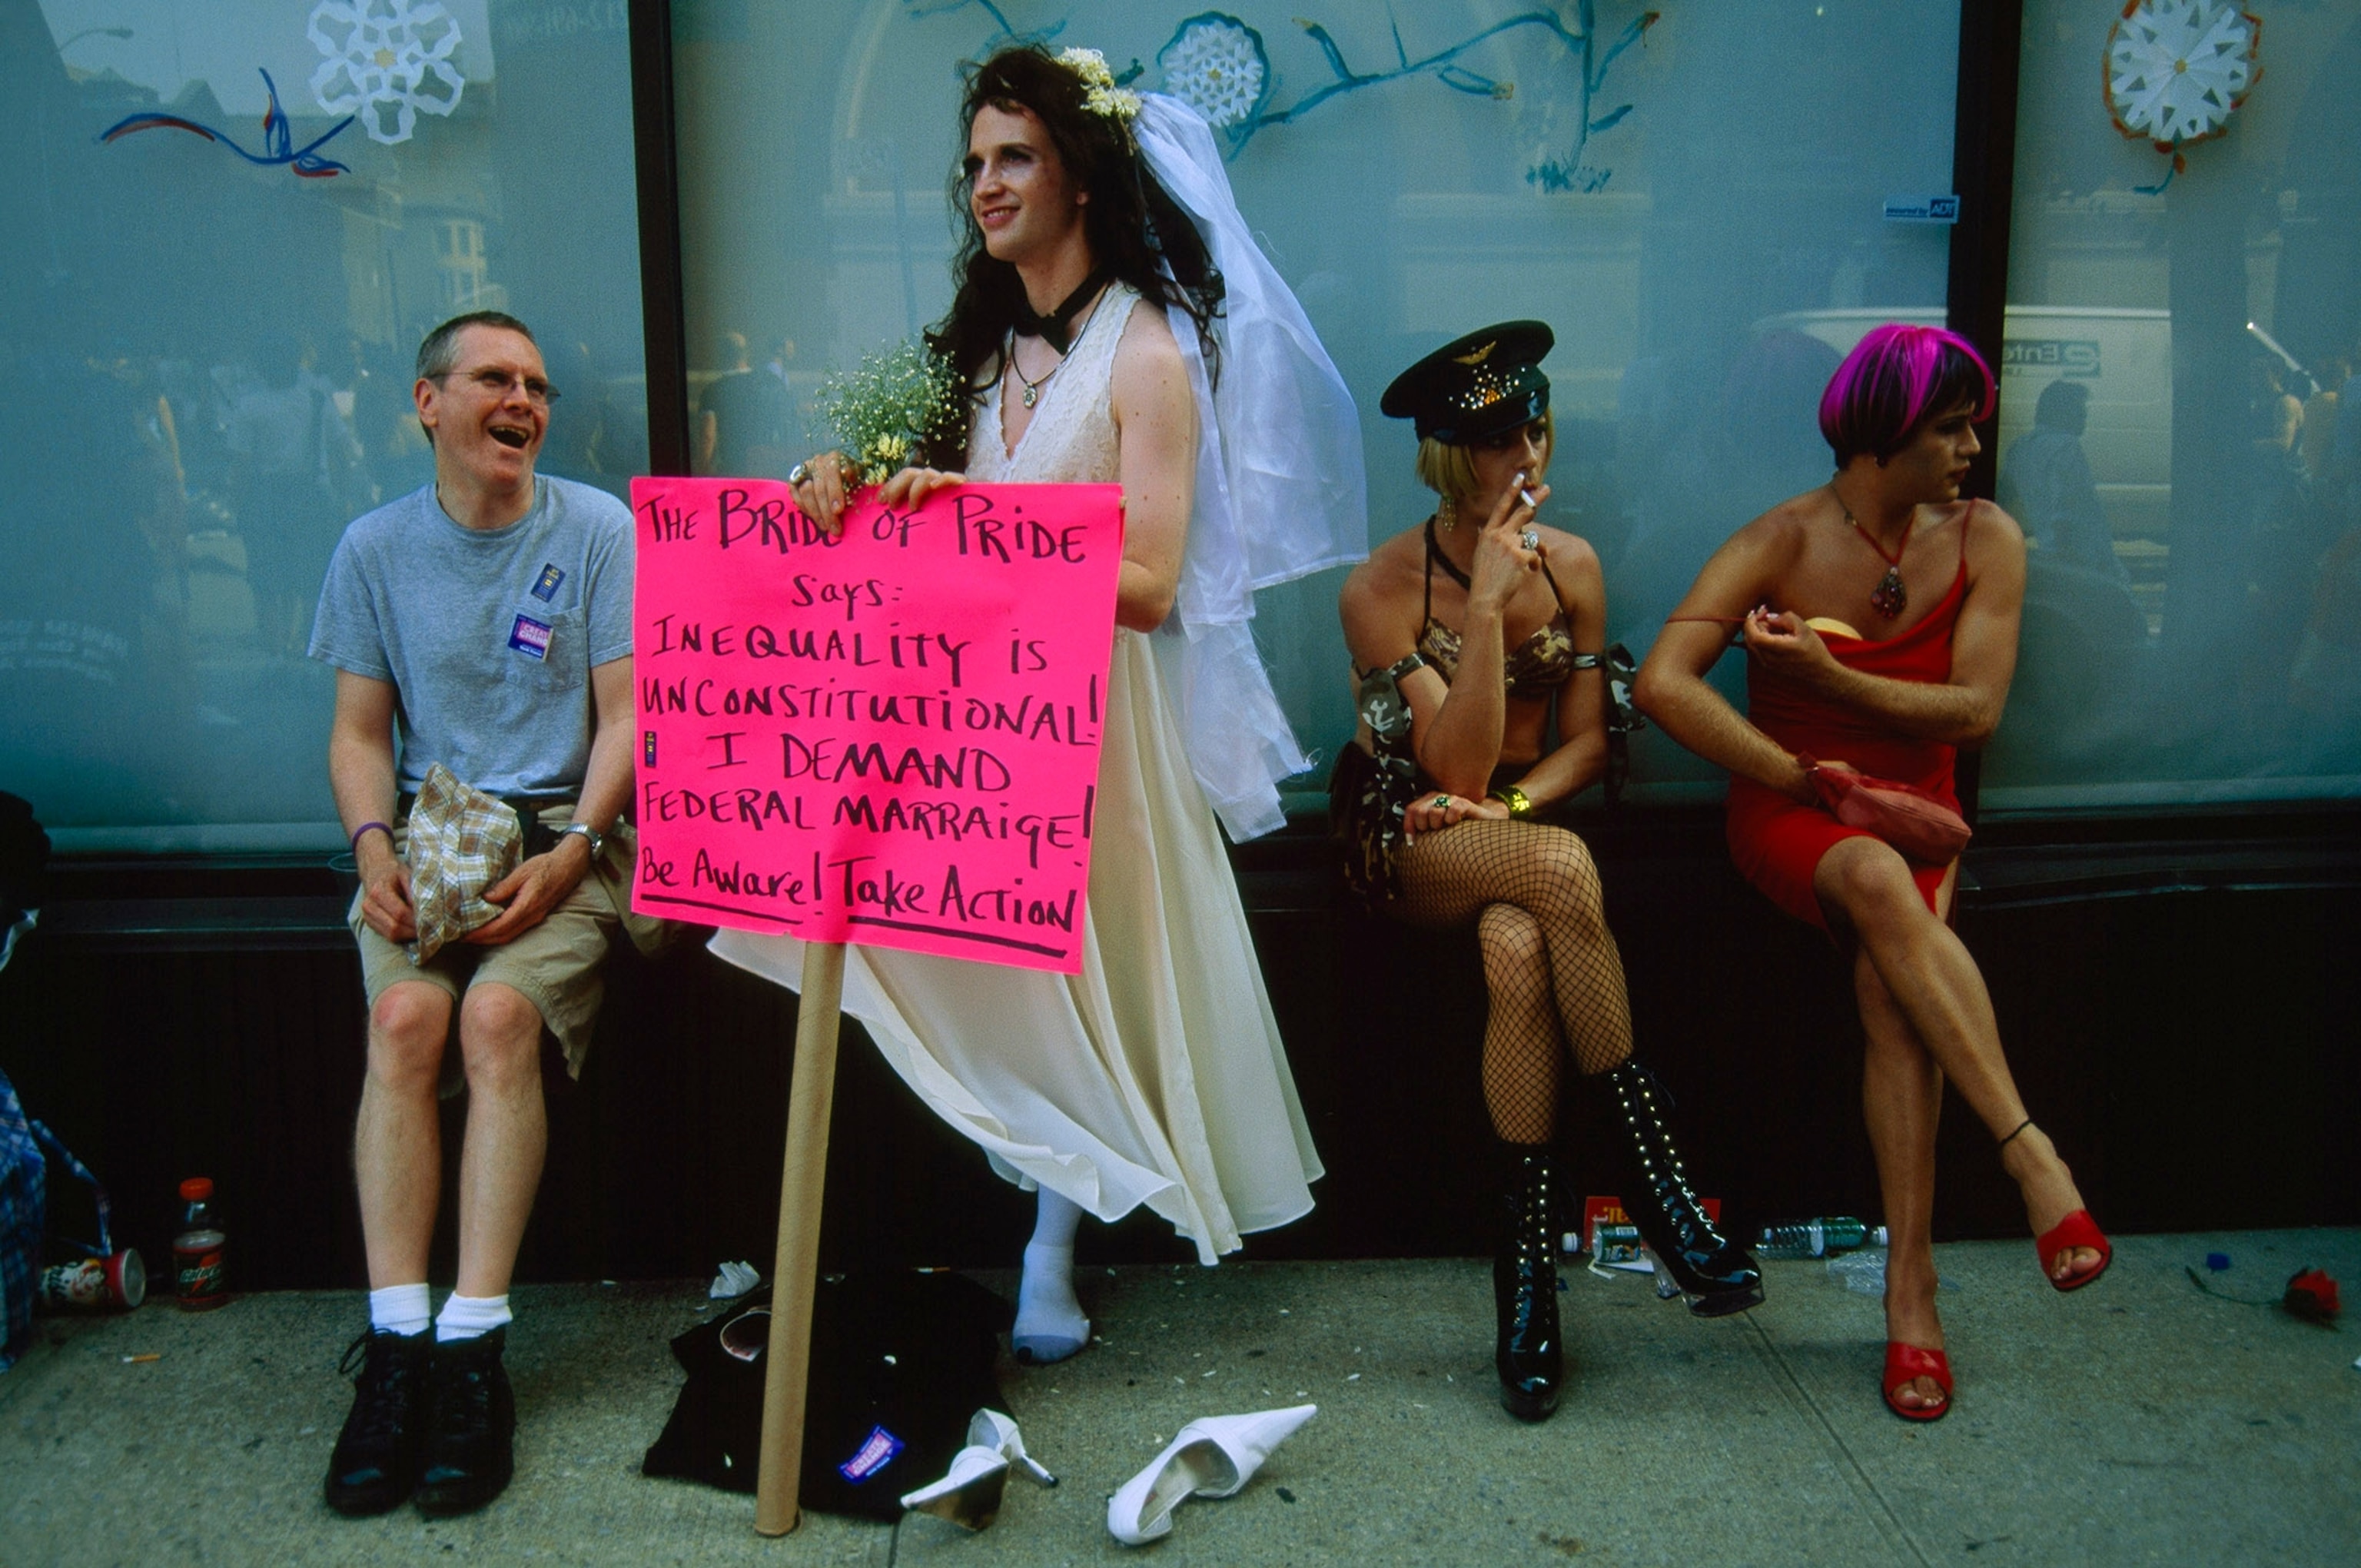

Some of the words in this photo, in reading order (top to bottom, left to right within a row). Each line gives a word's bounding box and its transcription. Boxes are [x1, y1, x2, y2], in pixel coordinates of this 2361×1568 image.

[1930, 201, 1956, 216] ADT
[638, 495, 697, 541] THE
[872, 508, 927, 548] OF
[952, 494, 1088, 564] PRIDE
[652, 614, 972, 687] INEQUALITY
[643, 674, 1098, 746] UNCONSTITUTIONAL!
[706, 732, 748, 769] I
[780, 733, 1011, 792] DEMAND
[645, 782, 816, 831] FEDERAL
[642, 847, 679, 887] Be
[693, 848, 823, 915] Aware!
[828, 855, 929, 917] Take
